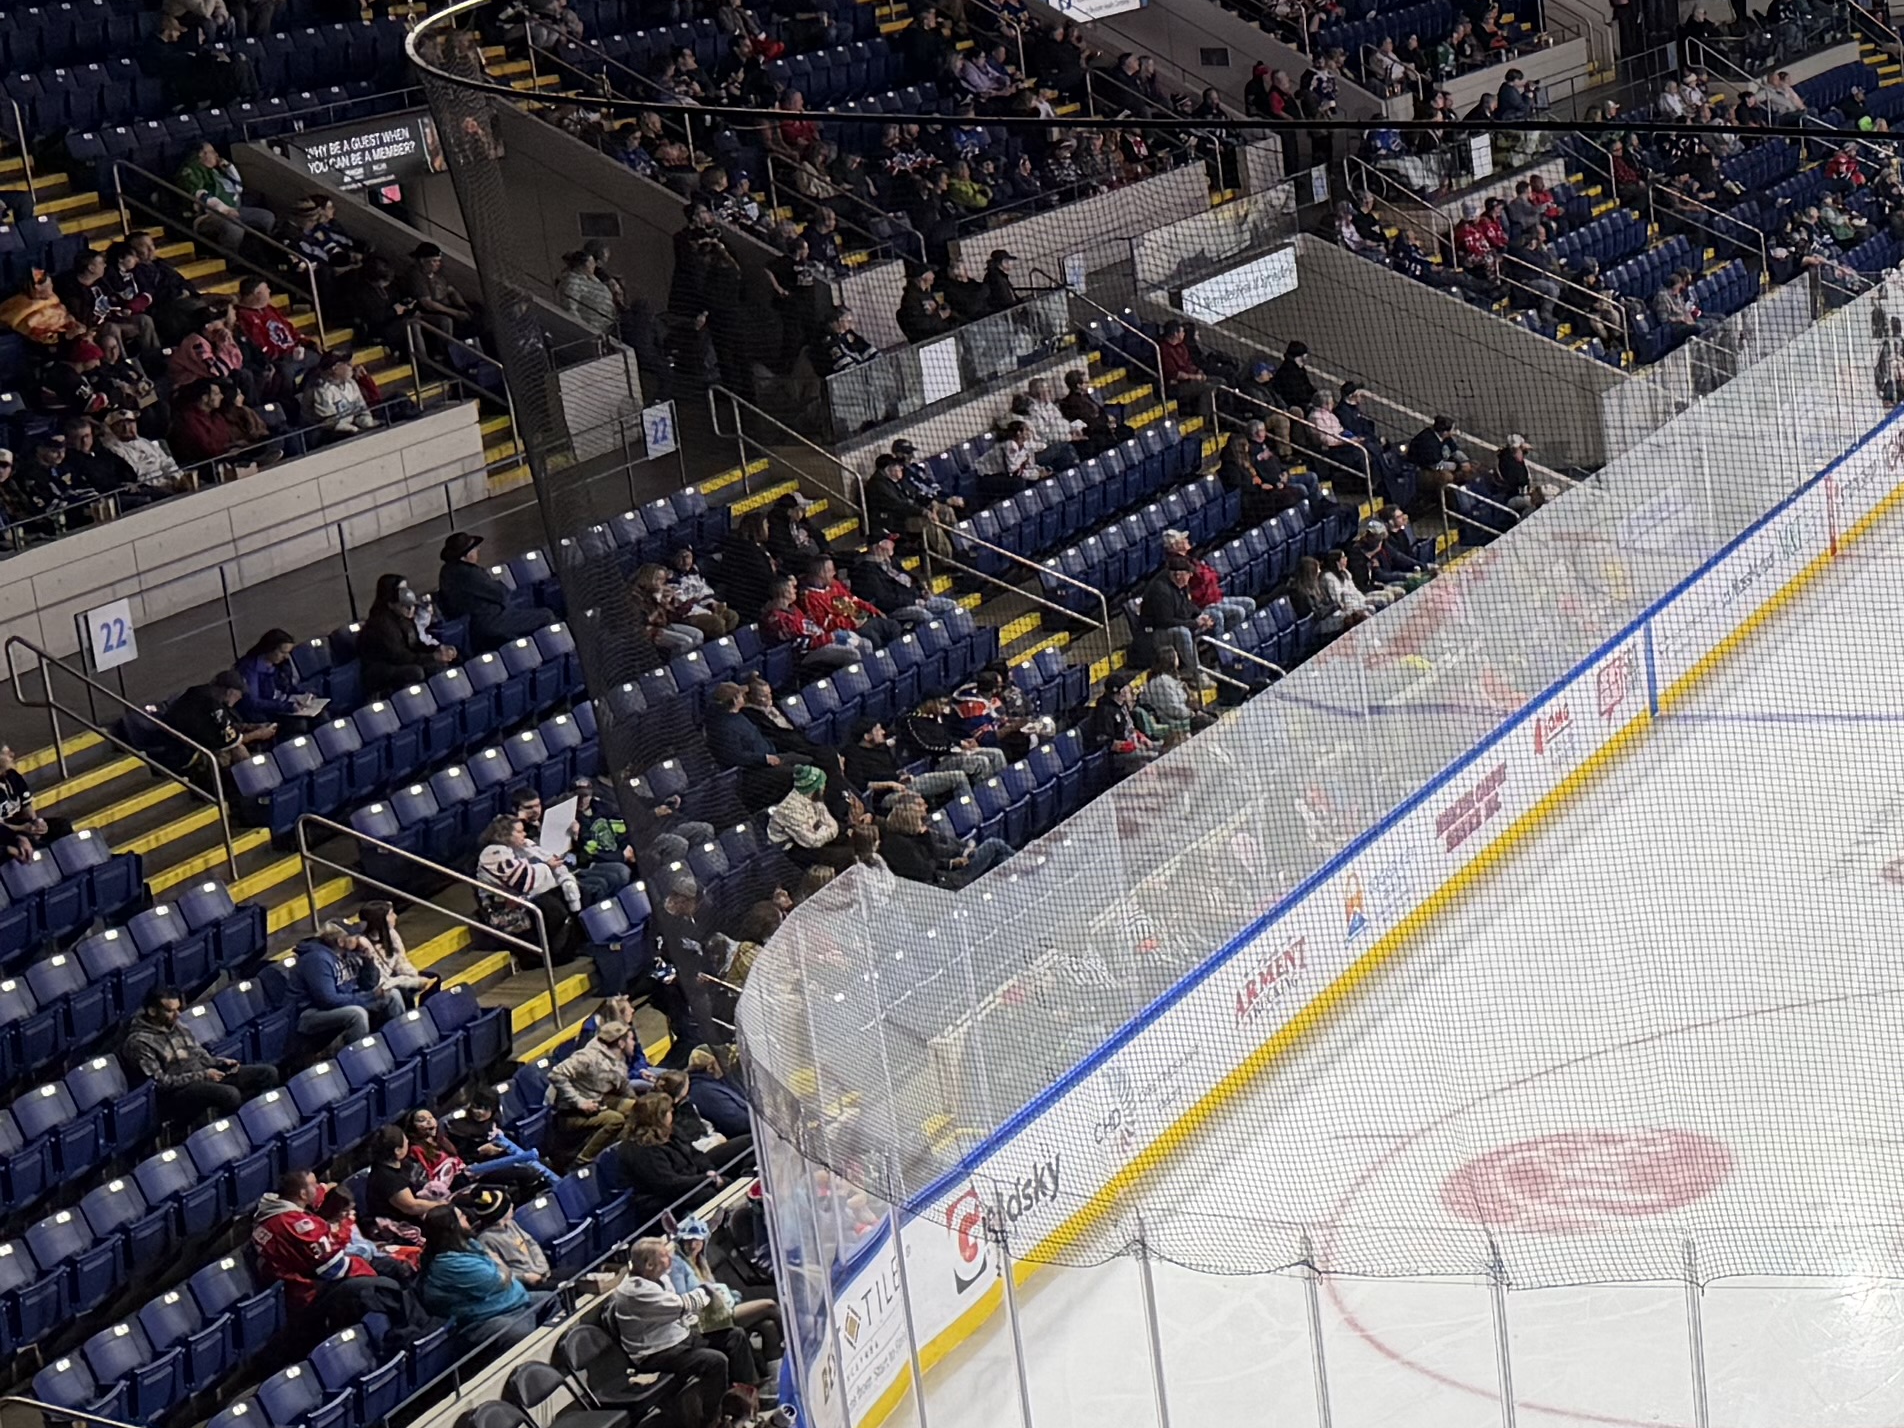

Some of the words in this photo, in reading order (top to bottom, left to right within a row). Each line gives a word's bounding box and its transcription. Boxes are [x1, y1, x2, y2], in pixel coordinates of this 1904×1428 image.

[305, 143, 328, 160] WHY
[329, 140, 342, 154] BE
[343, 139, 351, 152] A
[351, 133, 381, 149] GUEST
[381, 127, 411, 144] WHEN
[307, 161, 328, 175] YOU
[329, 156, 350, 170] CAN
[351, 153, 364, 166] BE
[364, 151, 372, 163] A
[372, 141, 416, 162] MEMBER?
[651, 417, 668, 445] 22
[100, 617, 128, 654] 22
[1235, 935, 1307, 1017] ARMENT
[860, 1255, 902, 1328] TILE
